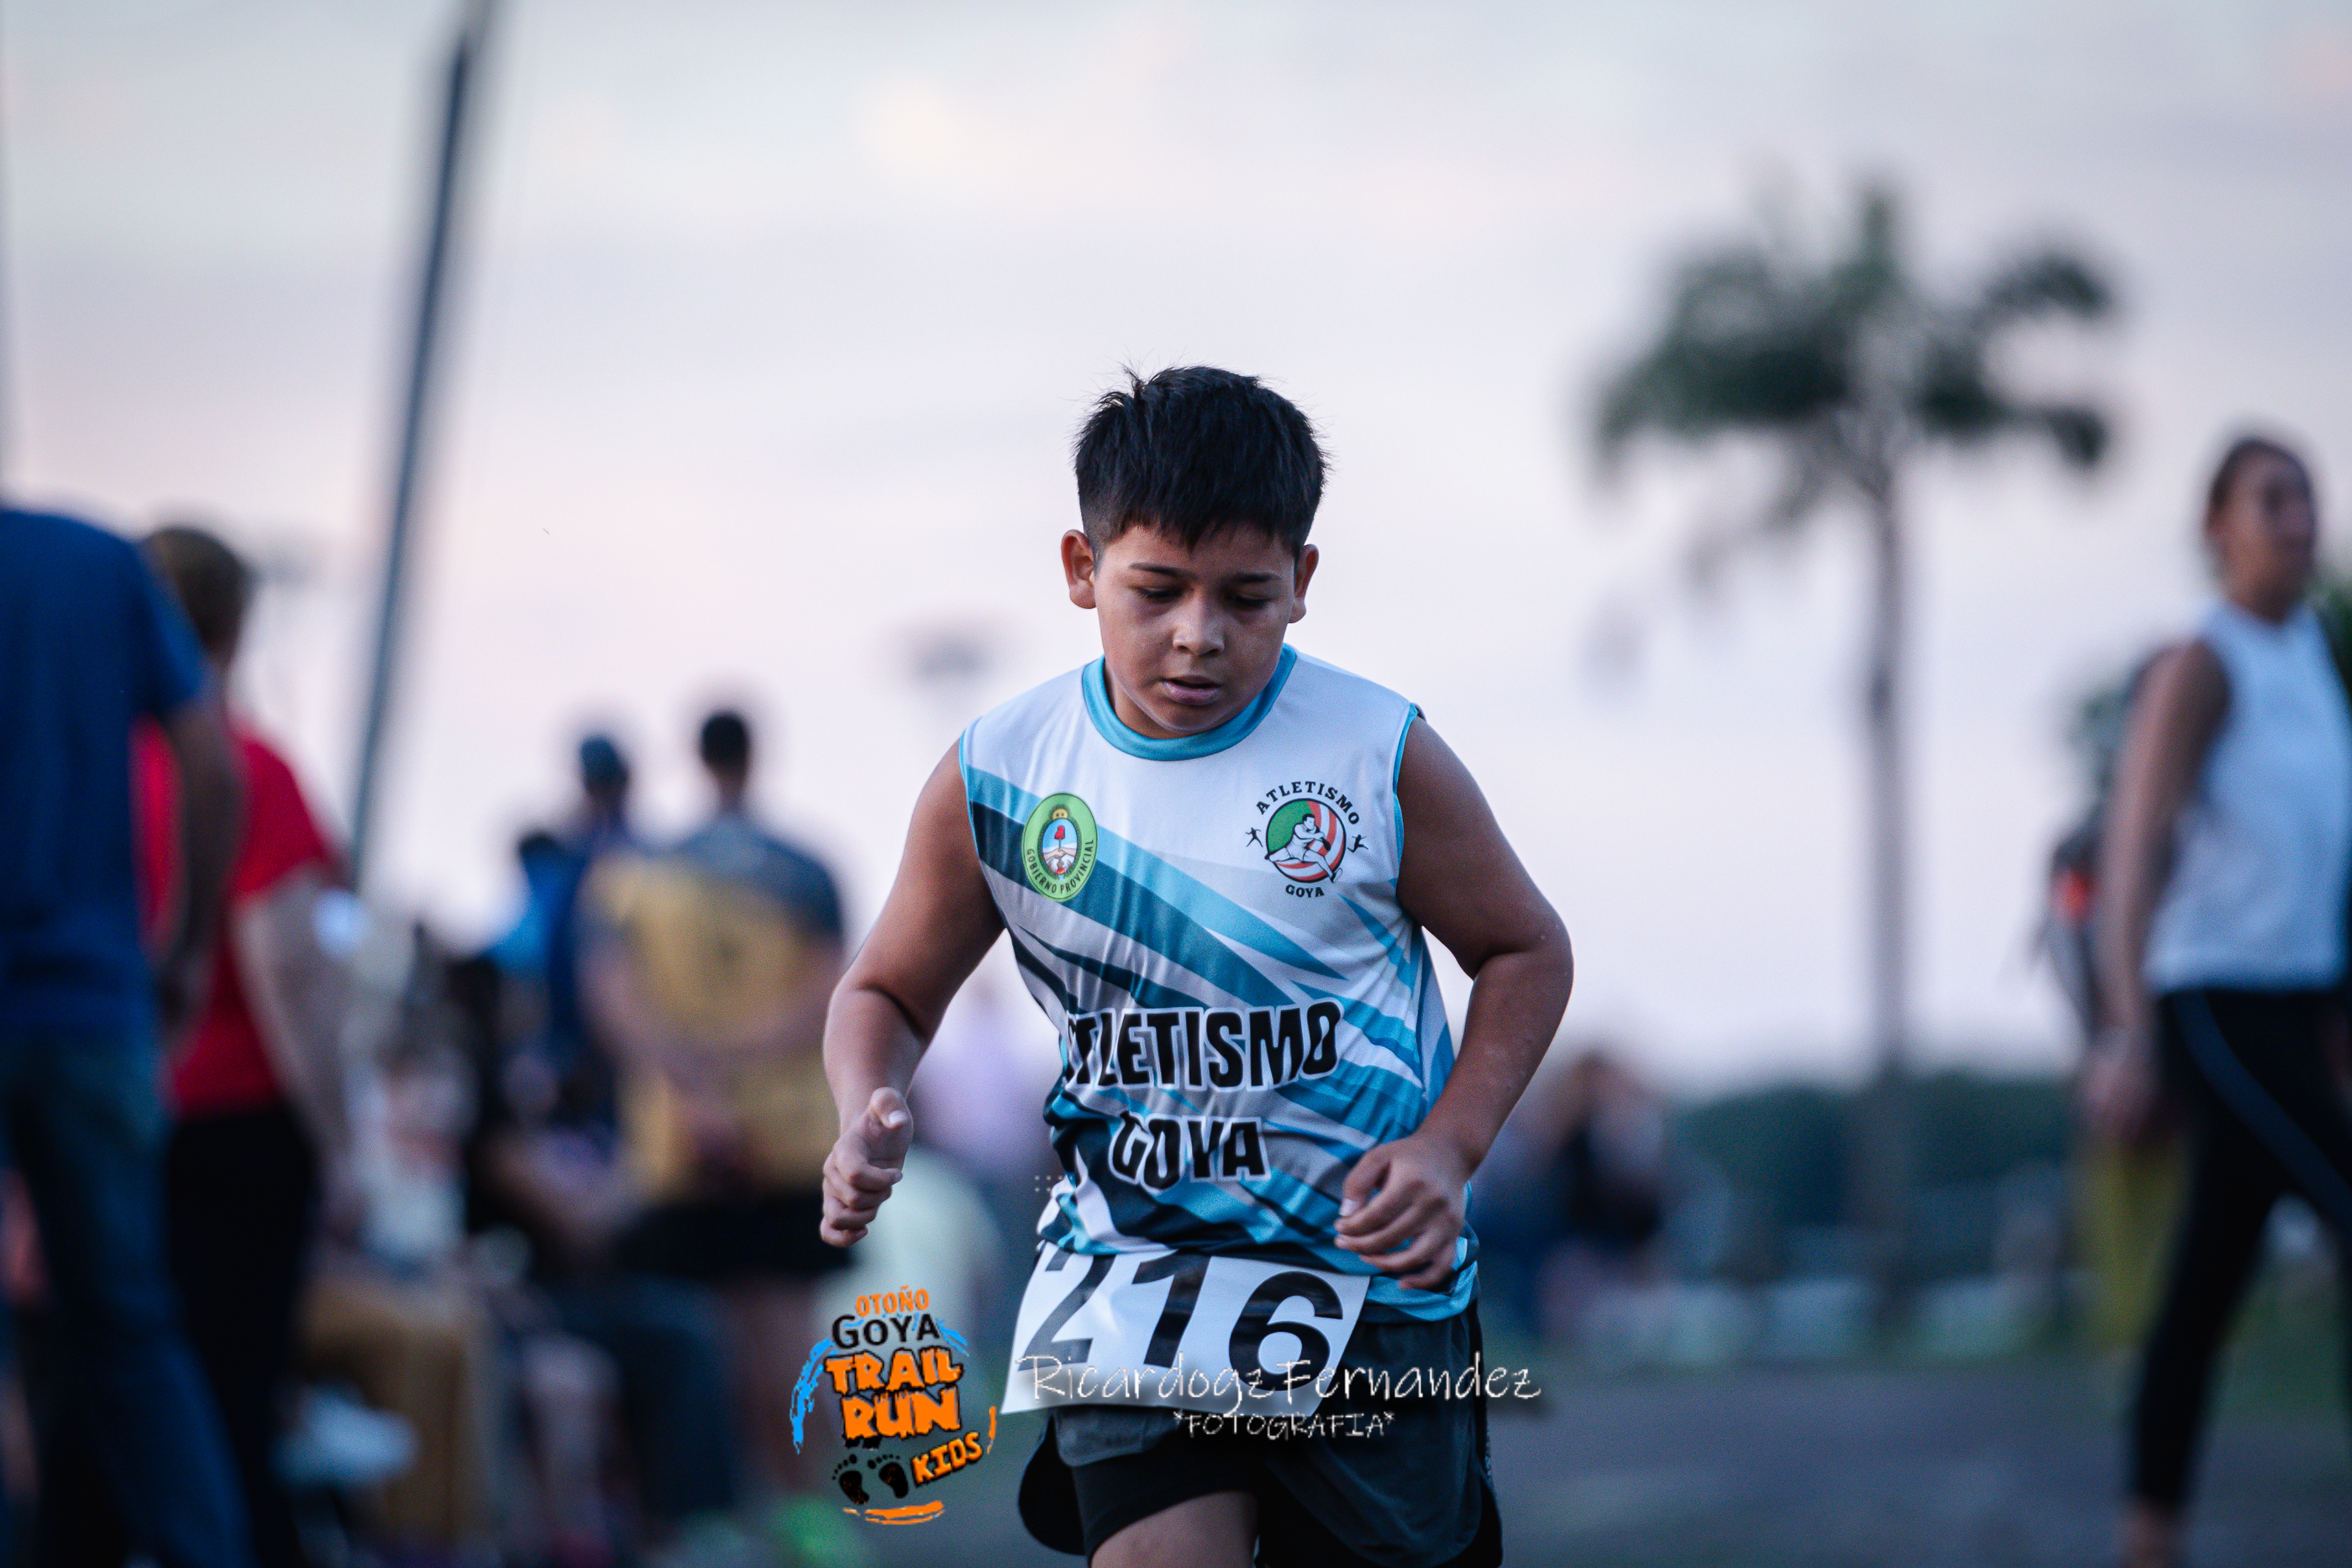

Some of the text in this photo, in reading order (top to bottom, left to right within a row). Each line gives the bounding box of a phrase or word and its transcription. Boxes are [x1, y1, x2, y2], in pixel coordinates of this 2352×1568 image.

[1256, 780, 1360, 825] ATLETISMO
[1026, 839, 1095, 894] GOBIERNO PROVINCIAL
[1285, 884, 1325, 899] GOYA
[1111, 1113, 1268, 1189] GOYA
[1018, 1251, 1345, 1392] 216
